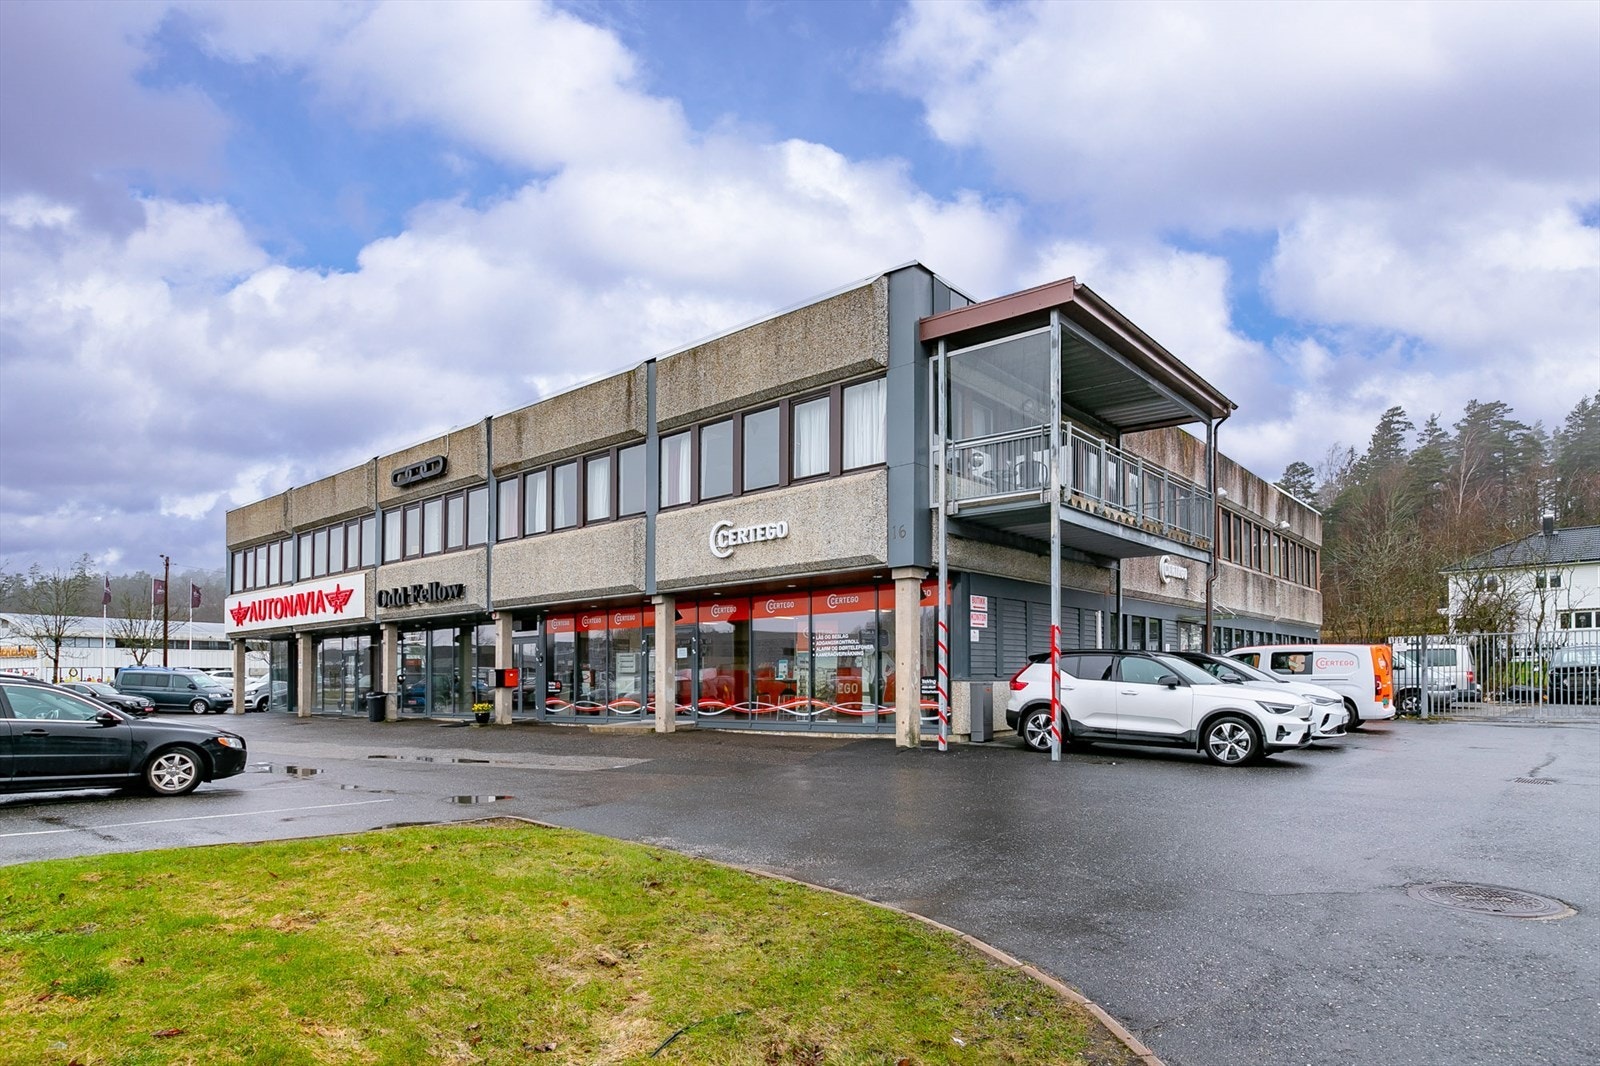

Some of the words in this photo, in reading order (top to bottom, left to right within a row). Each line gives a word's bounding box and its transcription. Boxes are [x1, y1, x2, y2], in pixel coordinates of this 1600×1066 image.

[710, 520, 789, 558] CERTEGO
[892, 524, 907, 540] 16
[376, 587, 409, 608] Odd
[409, 582, 465, 603] Fellow
[827, 593, 859, 609] CERTEGO
[248, 590, 327, 622] AUTONAVIA
[711, 604, 737, 618] CERTEGO
[765, 599, 795, 614] CERTEGO
[1315, 657, 1355, 670] CERTEGO
